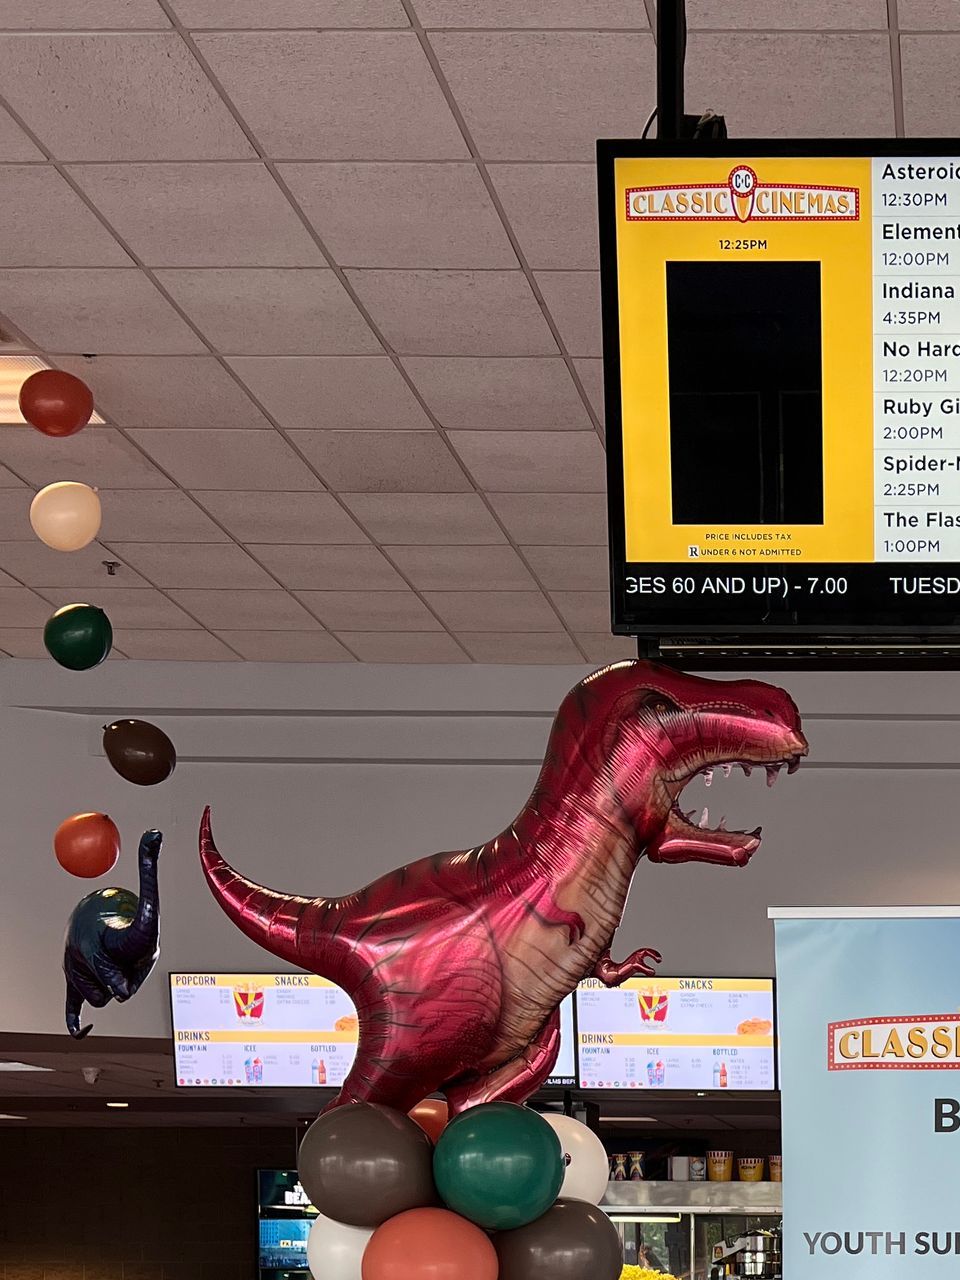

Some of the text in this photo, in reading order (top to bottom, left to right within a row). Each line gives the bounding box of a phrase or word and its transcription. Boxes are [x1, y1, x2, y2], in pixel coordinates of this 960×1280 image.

[633, 190, 849, 214] CLASSIC CINEMAS
[882, 193, 947, 207] 12:30PM
[719, 240, 767, 250] 12:25PM
[882, 252, 949, 266] 12:00PM
[883, 282, 954, 299] Indiana
[882, 311, 940, 325] 4:35PM
[883, 341, 910, 357] No
[883, 369, 947, 382] 12:20PM
[884, 398, 933, 418] Ruby
[883, 426, 943, 440] 2:00PM
[883, 483, 939, 496] 2:25PM
[883, 511, 919, 528] The
[884, 539, 940, 553] 1:00PM
[672, 577, 695, 594] 60
[701, 577, 745, 594] AND
[753, 577, 788, 598] UP)
[807, 577, 847, 594] 7.00
[176, 976, 216, 986] POPCORN
[275, 976, 309, 986] SNACKS
[679, 980, 713, 990] SNACKS
[178, 1031, 210, 1041] DRINKS
[582, 1034, 614, 1044] DRINKS
[803, 1231, 906, 1255] YOUTH
